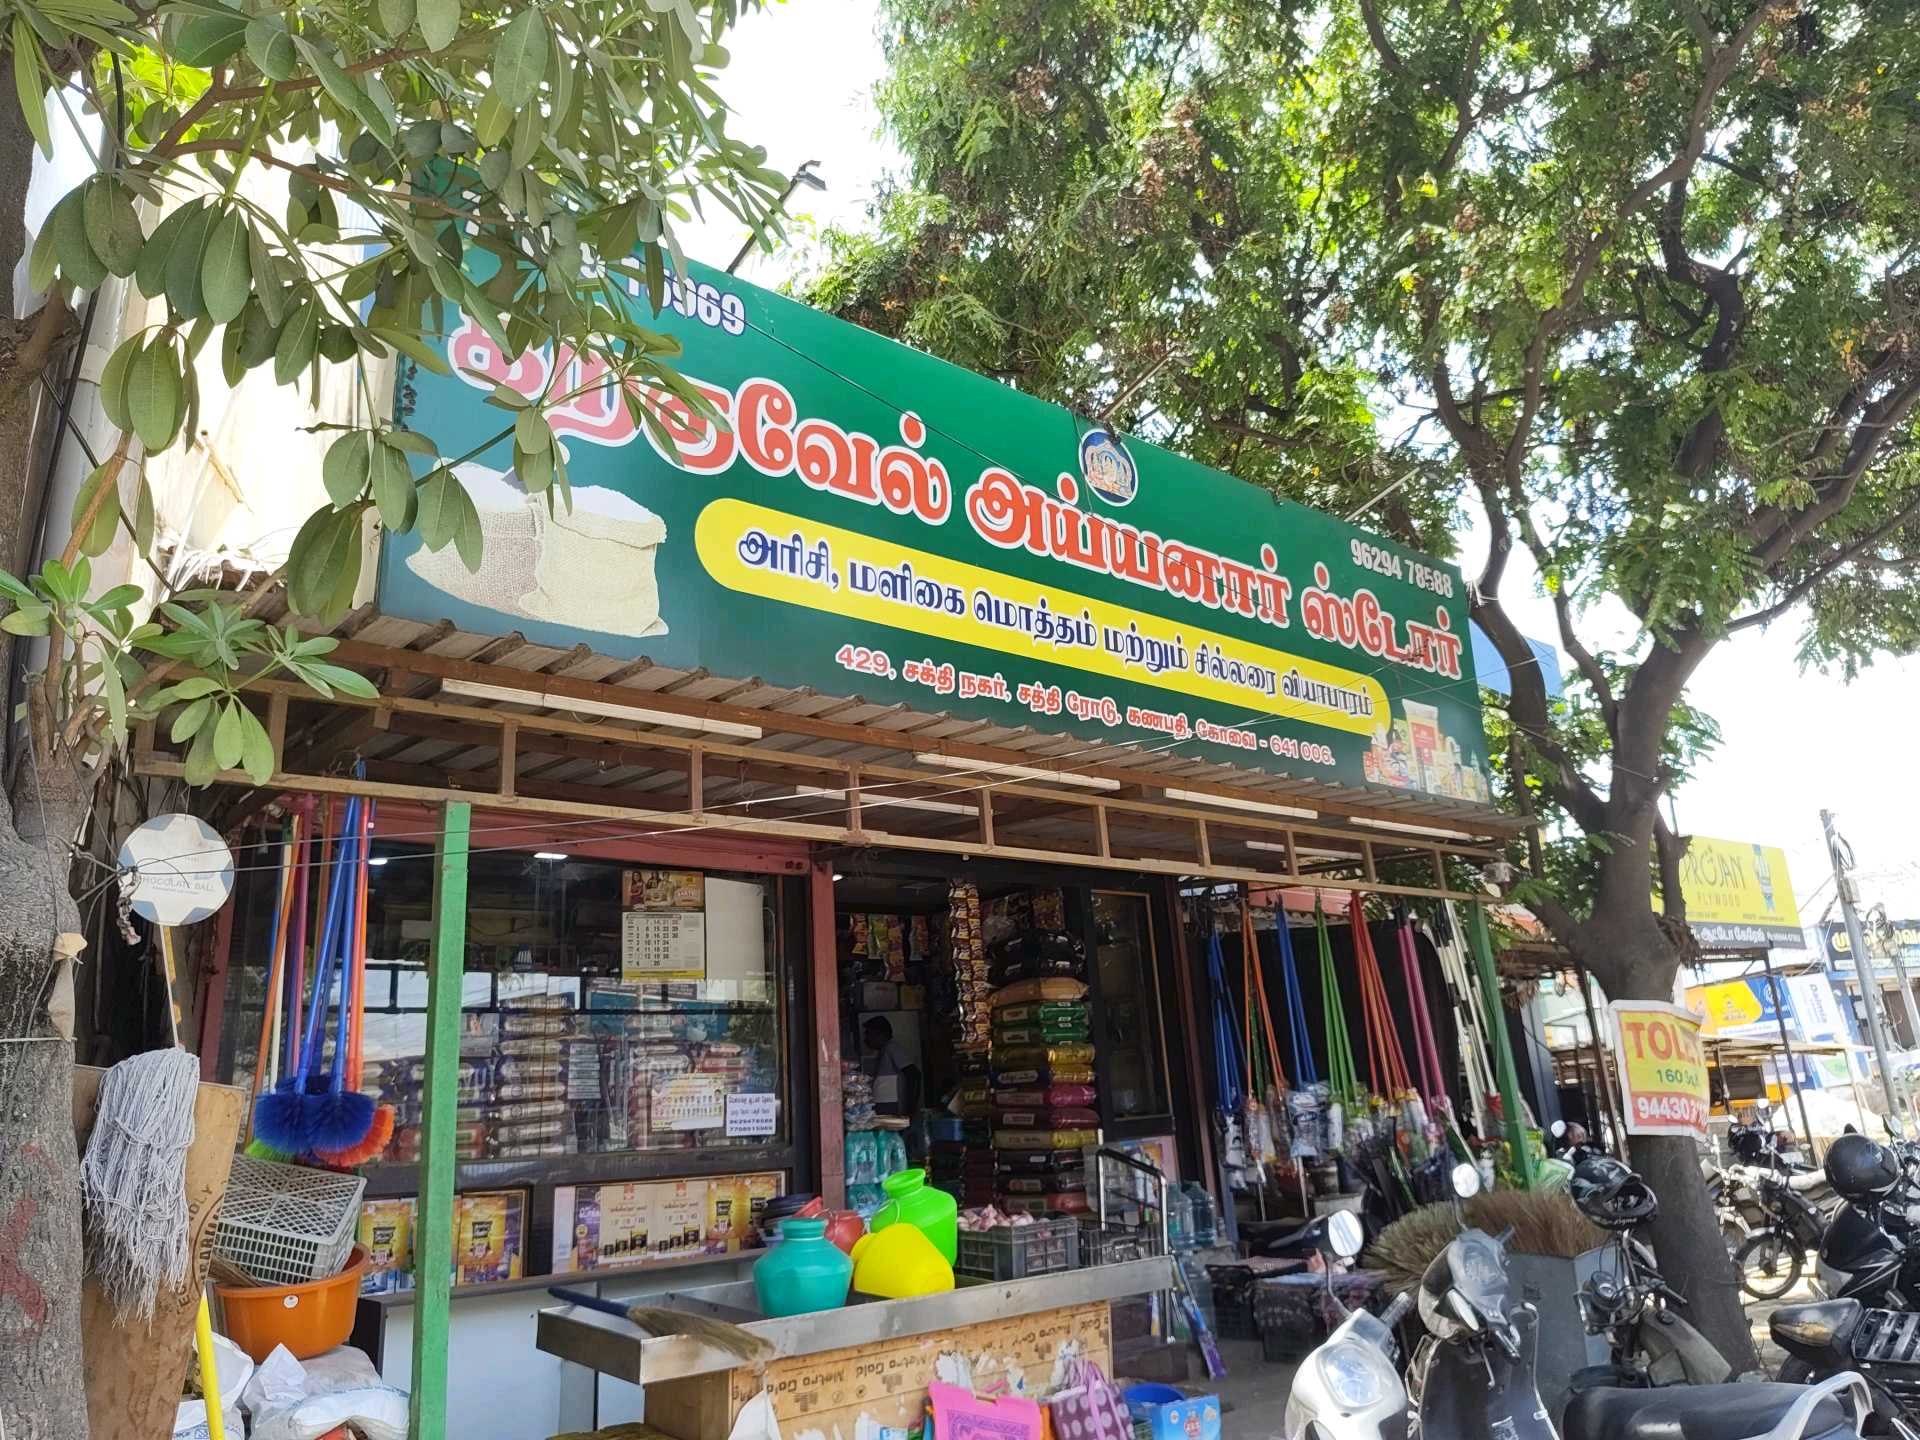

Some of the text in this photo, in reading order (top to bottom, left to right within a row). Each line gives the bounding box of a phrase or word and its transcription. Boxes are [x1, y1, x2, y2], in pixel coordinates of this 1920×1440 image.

[966, 467, 1290, 629] அய்யனார்
[1301, 562, 1462, 680] ஸ்டோர்
[1351, 539, 1402, 580] 96294
[737, 531, 1373, 716] அரிசி, மளிகை மொத்தம் மற்றும் சில்லரை வியாபாரம்
[836, 644, 897, 680] 429,
[903, 658, 955, 694] சக்தி
[1017, 681, 1062, 715] சத்தி
[1196, 719, 1256, 750] கோவை
[1271, 735, 1299, 758] 641
[856, 1360, 885, 1377] Gold
